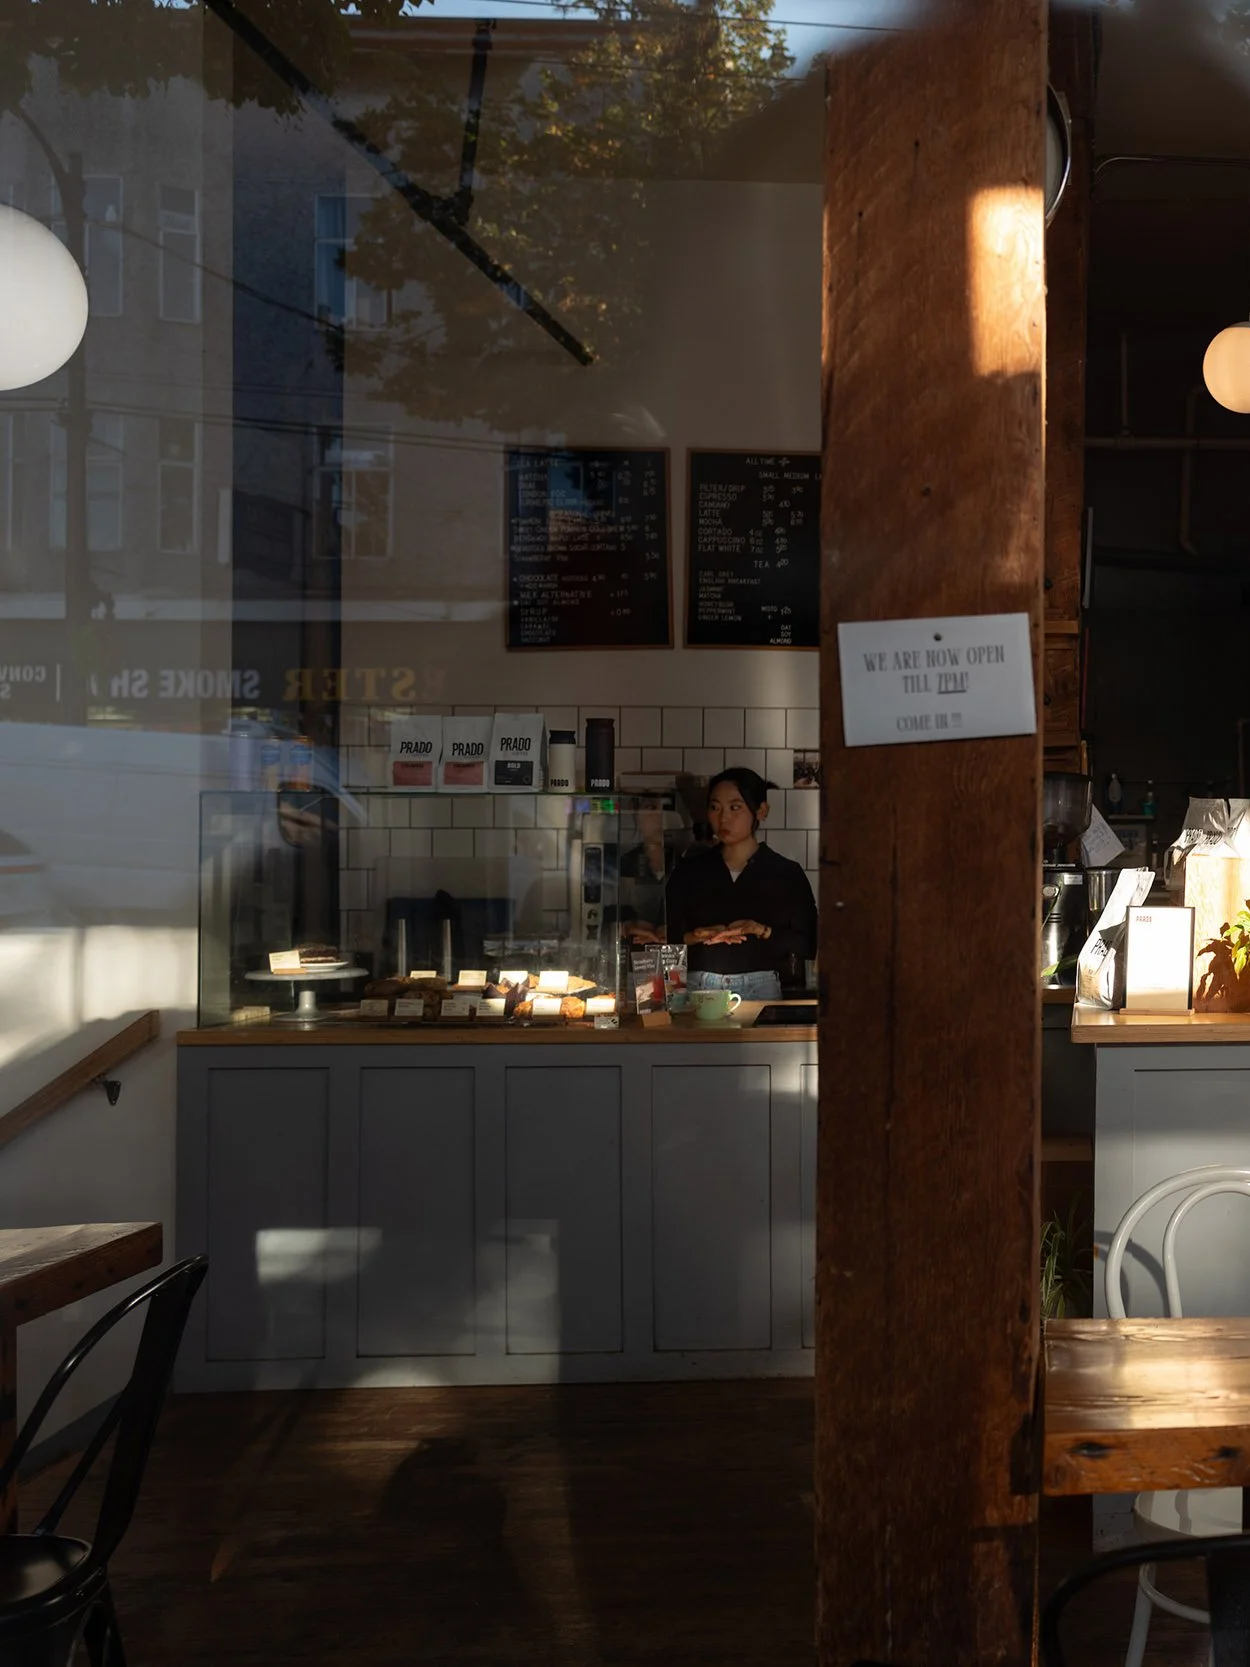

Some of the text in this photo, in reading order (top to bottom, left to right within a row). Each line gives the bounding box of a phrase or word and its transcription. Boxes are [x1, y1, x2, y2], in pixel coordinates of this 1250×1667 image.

[758, 471, 780, 479] SMALL
[699, 492, 737, 501] ESPRESSO
[699, 509, 720, 517] LATTE
[698, 527, 732, 536] CORTADO
[698, 536, 745, 544] CAPPUCCINO
[698, 544, 715, 552] FLAT
[718, 544, 741, 552] WHITE
[754, 560, 769, 569] TEA
[541, 590, 592, 598] ALTERNATIVE
[863, 645, 1005, 672] WE ARE NOW OPEN
[902, 674, 931, 694] TILL
[897, 714, 931, 731] COME
[934, 713, 949, 730] IN
[399, 741, 433, 755] PRADO
[500, 736, 532, 752] PRADO
[452, 742, 484, 757] PRADO
[550, 778, 569, 788] PRADO
[590, 778, 610, 788] PRADO
